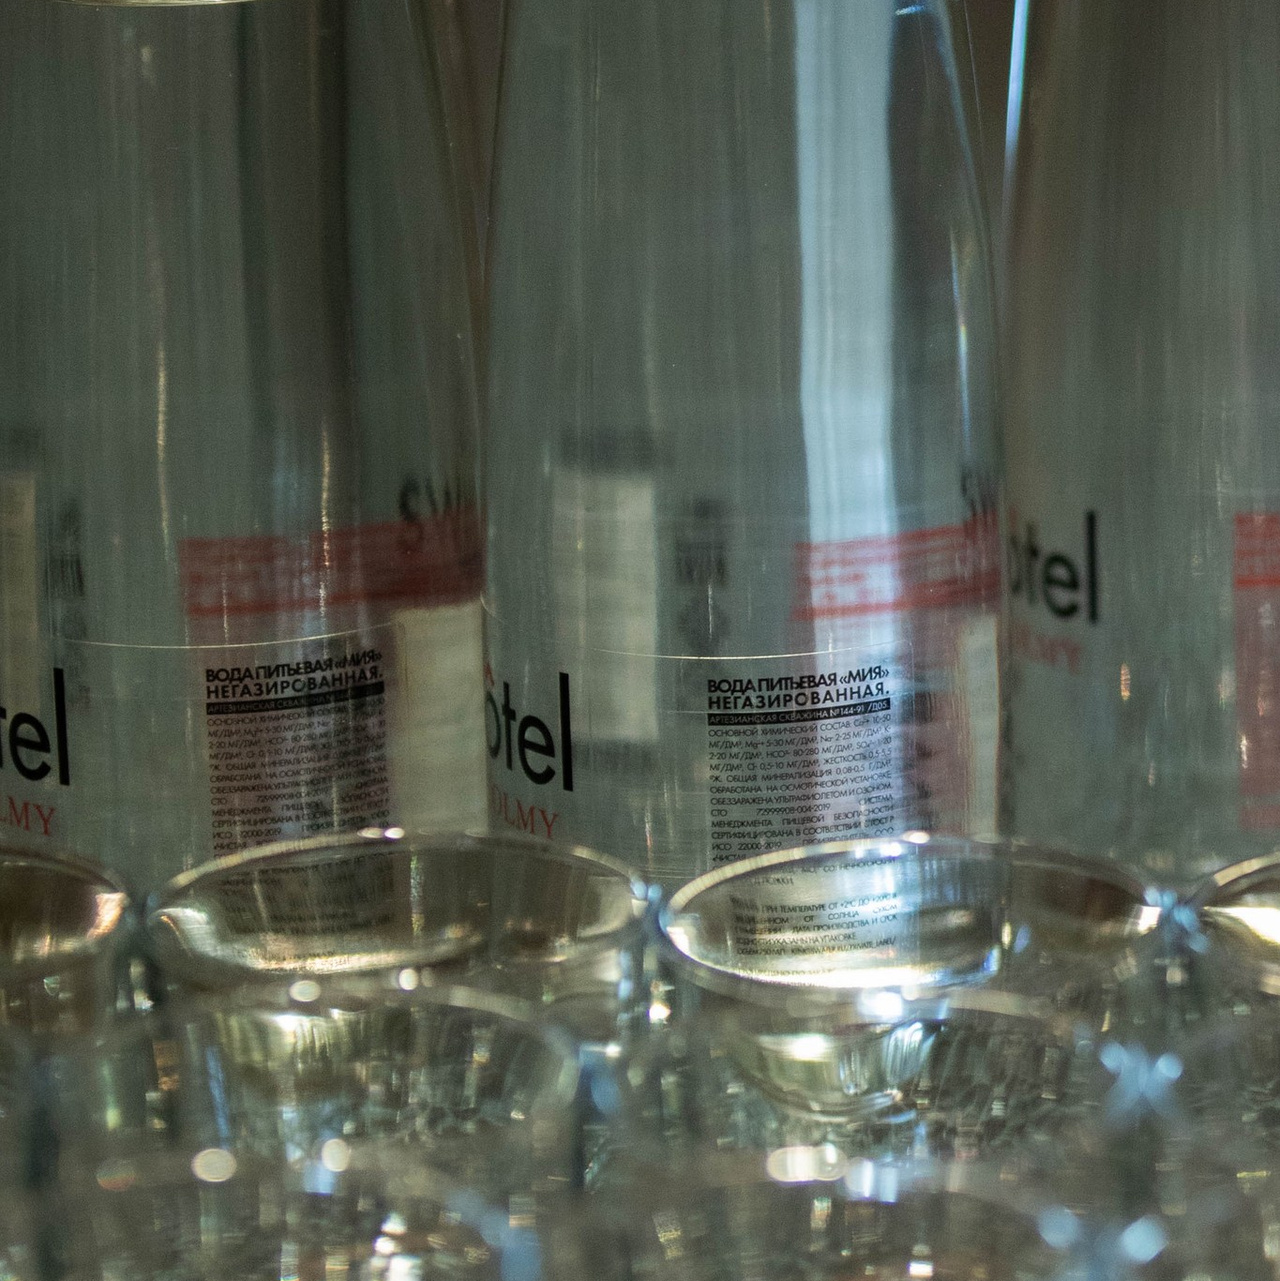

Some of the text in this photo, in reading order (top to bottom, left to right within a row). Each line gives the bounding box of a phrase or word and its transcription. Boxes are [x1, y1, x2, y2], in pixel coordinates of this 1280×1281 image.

[206, 668, 254, 683] ВОДА
[708, 666, 889, 695] ВОДА ПИТЬЕВАЯ «МИЯ»
[708, 682, 889, 710] НЕГАЗИРОВАННАЯ.
